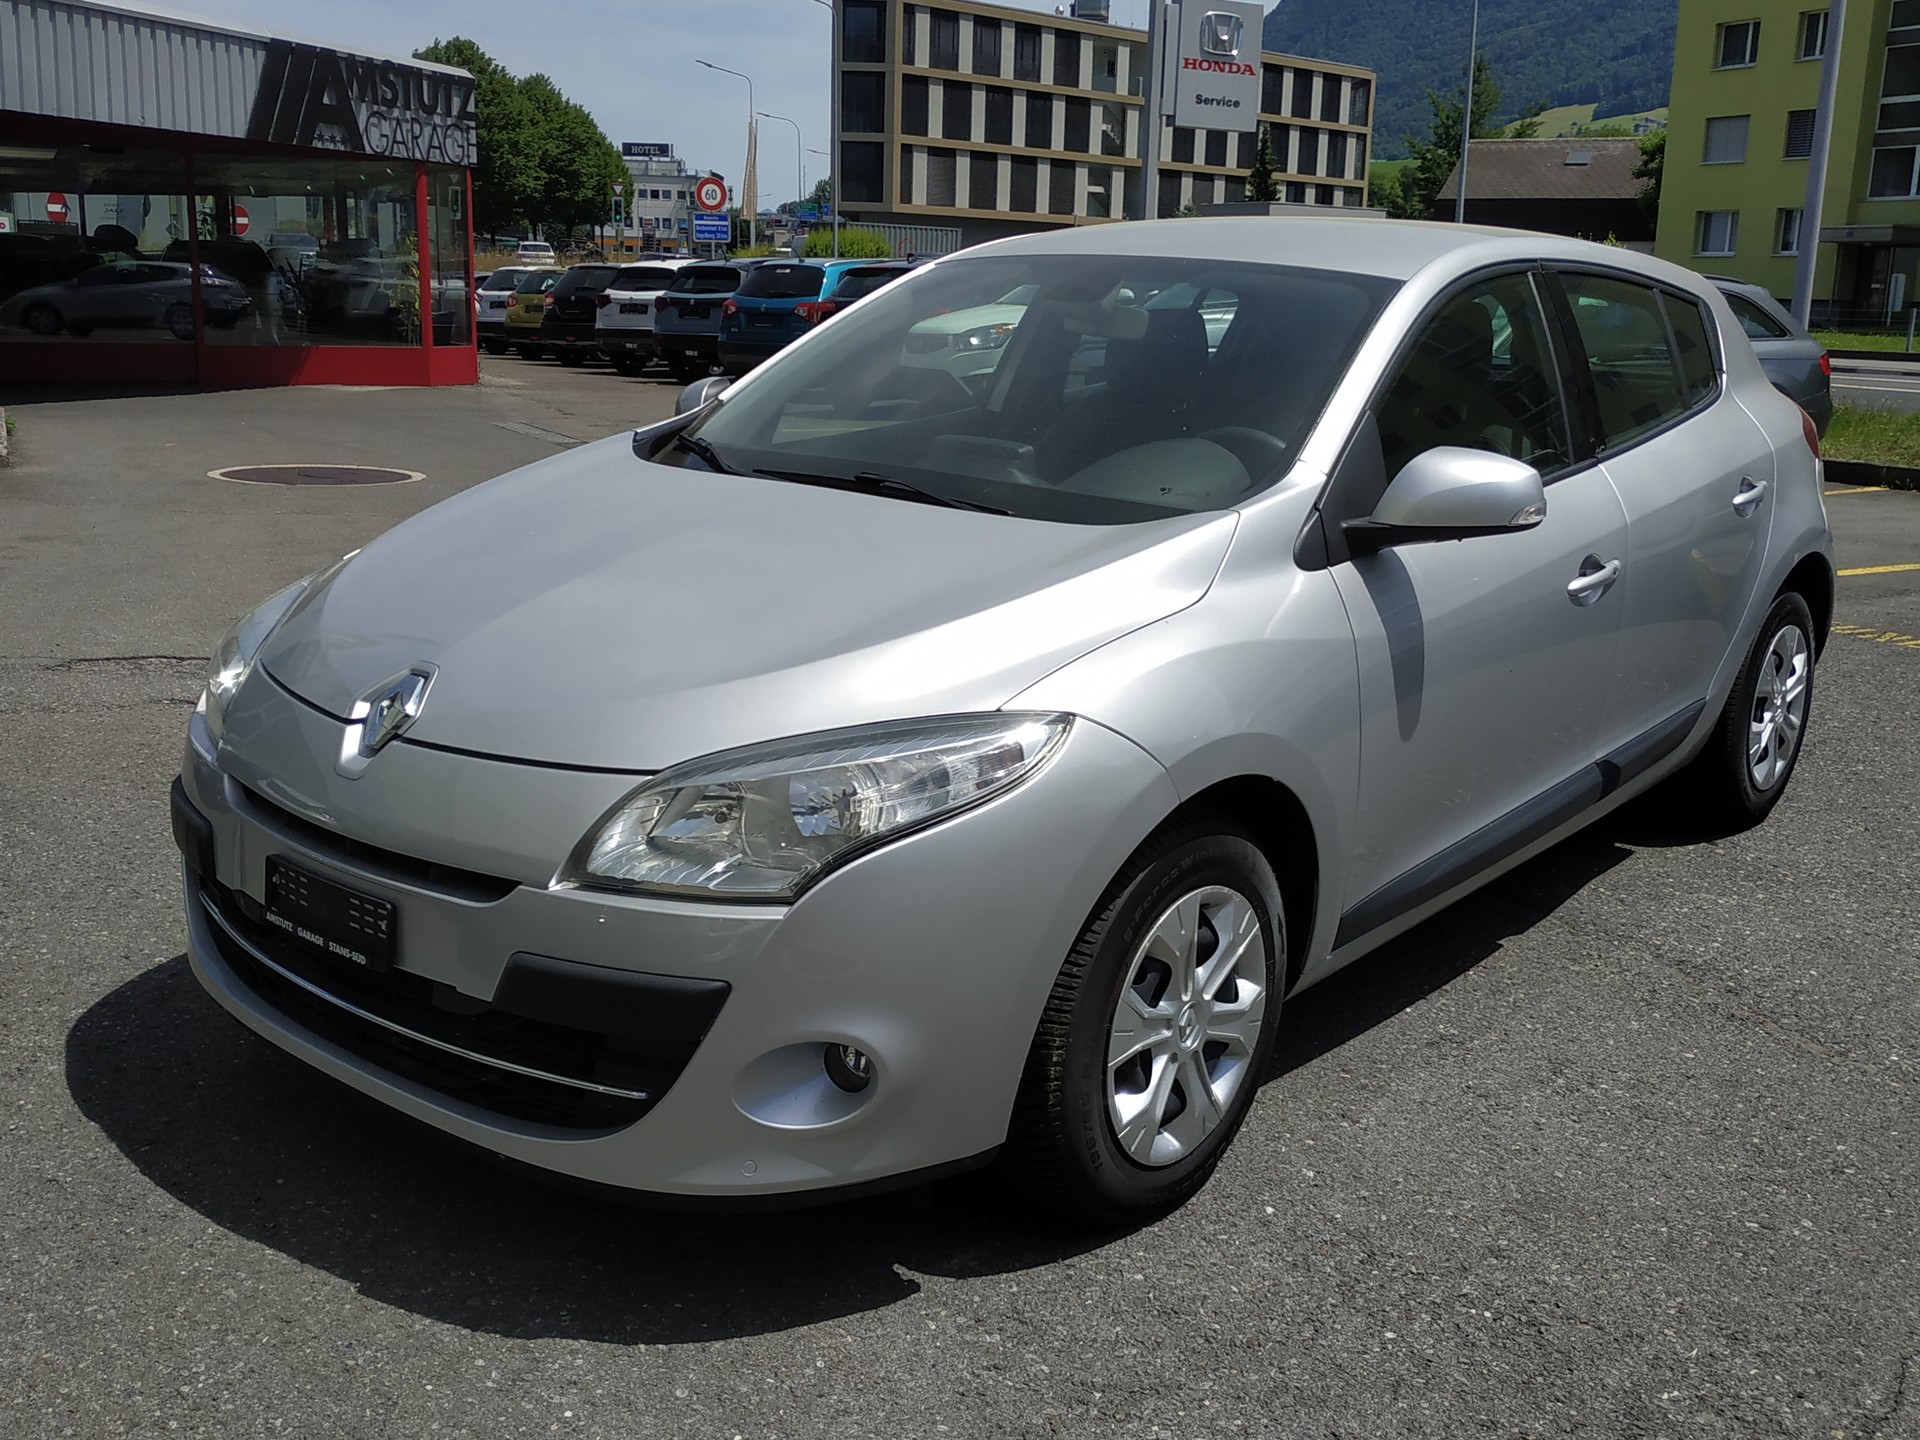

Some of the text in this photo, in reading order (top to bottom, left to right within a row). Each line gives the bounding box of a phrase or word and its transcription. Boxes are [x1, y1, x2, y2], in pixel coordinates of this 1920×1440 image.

[1182, 57, 1256, 76] HONDA
[294, 46, 476, 153] AMSTUTZ
[1195, 93, 1240, 108] Service
[365, 111, 477, 167] GARAGE
[631, 145, 661, 154] HOTEL
[705, 188, 717, 201] 60
[266, 911, 366, 965] AMSTUTZ GARAGE STANS-SÜD
